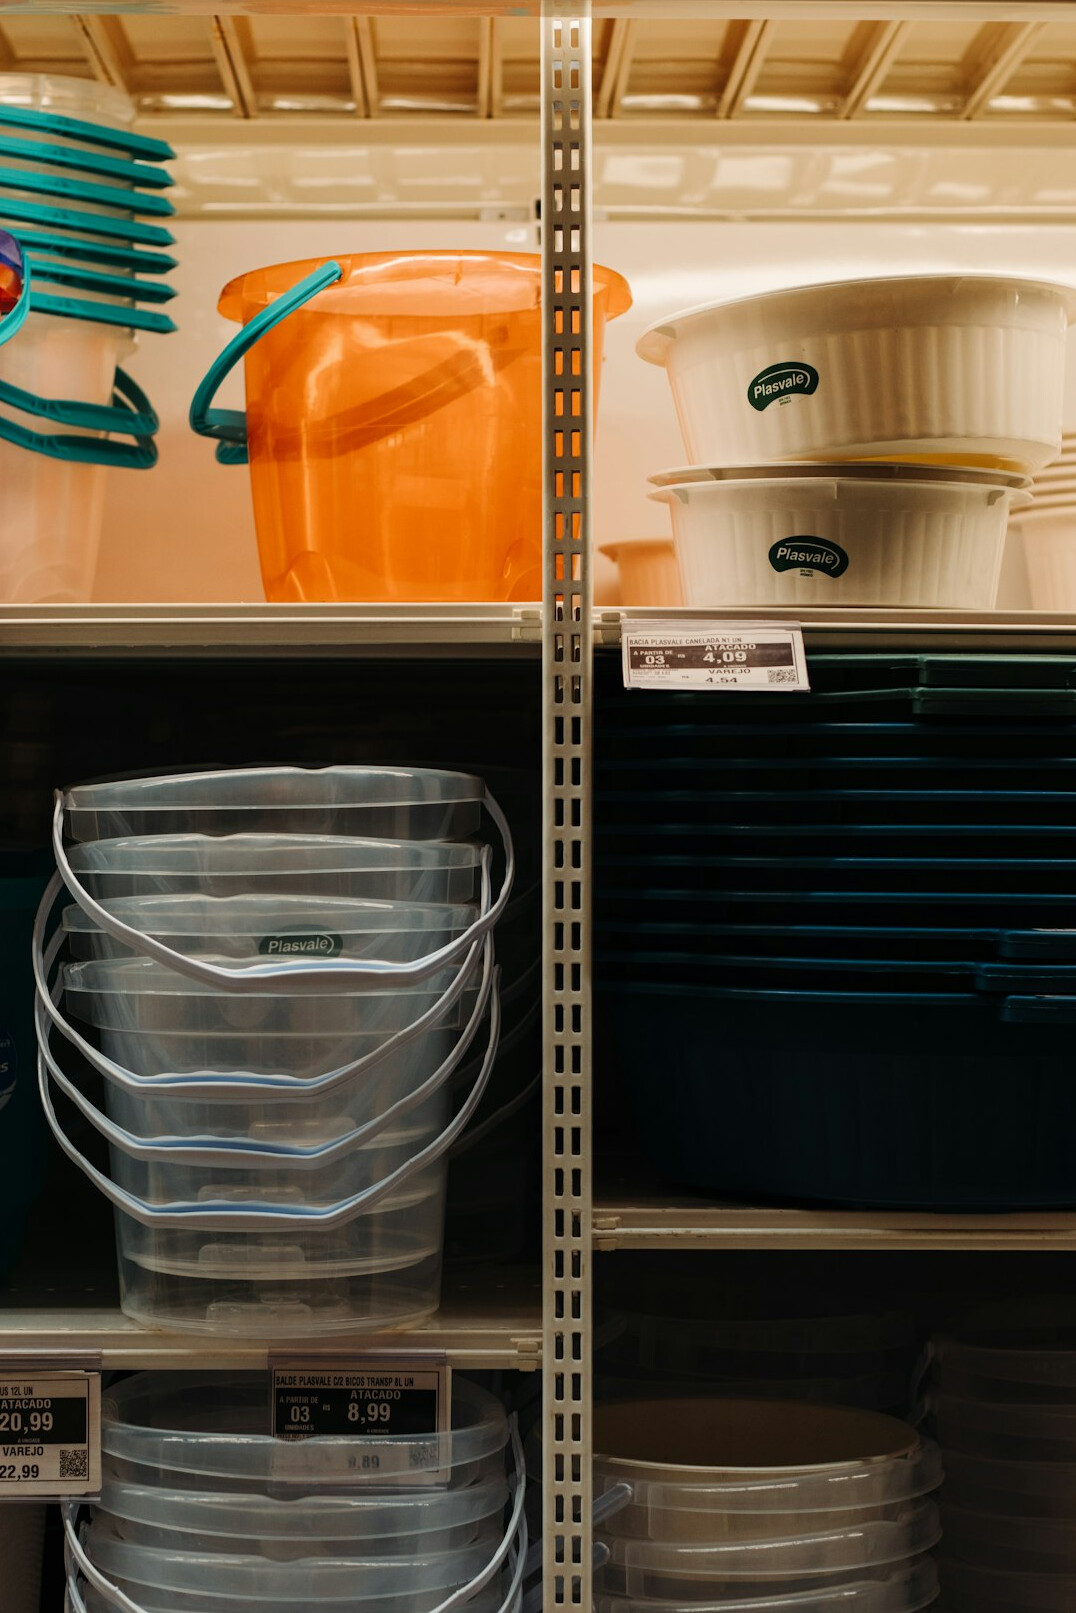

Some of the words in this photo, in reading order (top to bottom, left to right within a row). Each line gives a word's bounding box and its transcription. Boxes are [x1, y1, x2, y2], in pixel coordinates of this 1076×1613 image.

[754, 373, 804, 399] Plasvale
[776, 547, 834, 564] Plasvale
[645, 656, 666, 664] 03
[703, 651, 747, 664] 4,09
[268, 937, 328, 953] Plasvale
[276, 1376, 296, 1386] BALDE
[299, 1376, 332, 1386] PLASVALE
[346, 1376, 364, 1386] BICOS
[367, 1377, 393, 1386] TRANSP
[404, 1377, 414, 1386] UN
[10, 1386, 21, 1396] 12L
[24, 1386, 33, 1396] UN
[350, 1390, 400, 1400] ATACADO
[1, 1398, 52, 1409] ATACADO
[290, 1406, 310, 1422] 03
[348, 1402, 390, 1424] 8,99
[0, 1412, 54, 1434] 20,99
[3, 1446, 44, 1456] VAREJO
[0, 1464, 39, 1481] 22,99
